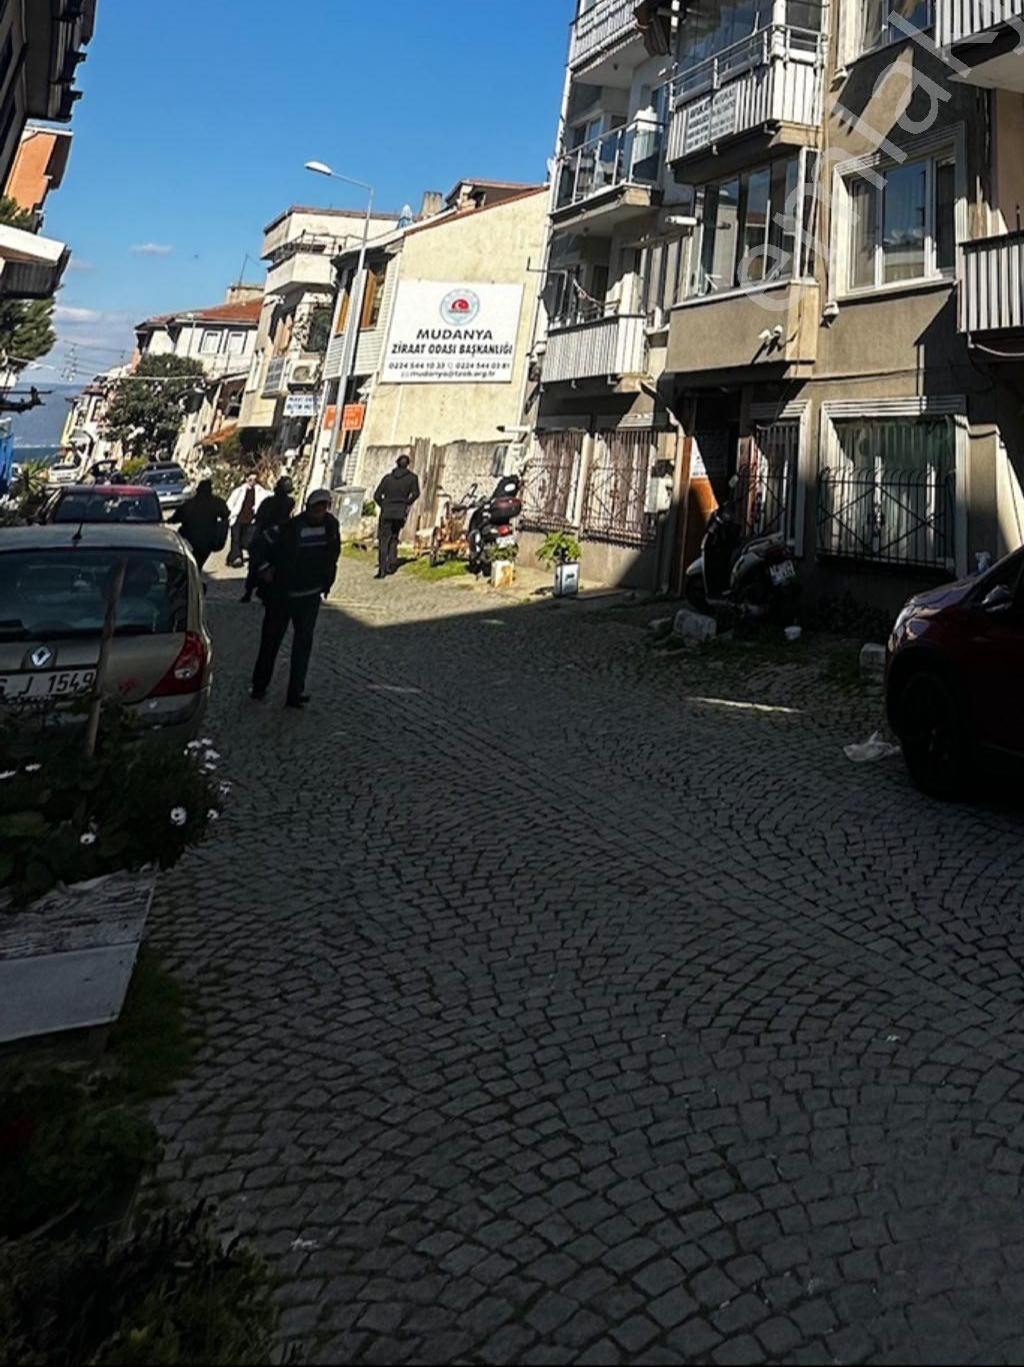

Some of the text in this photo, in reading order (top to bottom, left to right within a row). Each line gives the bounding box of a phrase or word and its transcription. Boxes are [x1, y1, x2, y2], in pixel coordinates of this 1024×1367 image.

[416, 328, 493, 340] MUDANYA
[391, 340, 513, 358] ZİRAAT ODASI BAŞKANLIĞI
[388, 361, 408, 370] 0224
[455, 361, 474, 370] 0224
[48, 671, 95, 693] 1549
